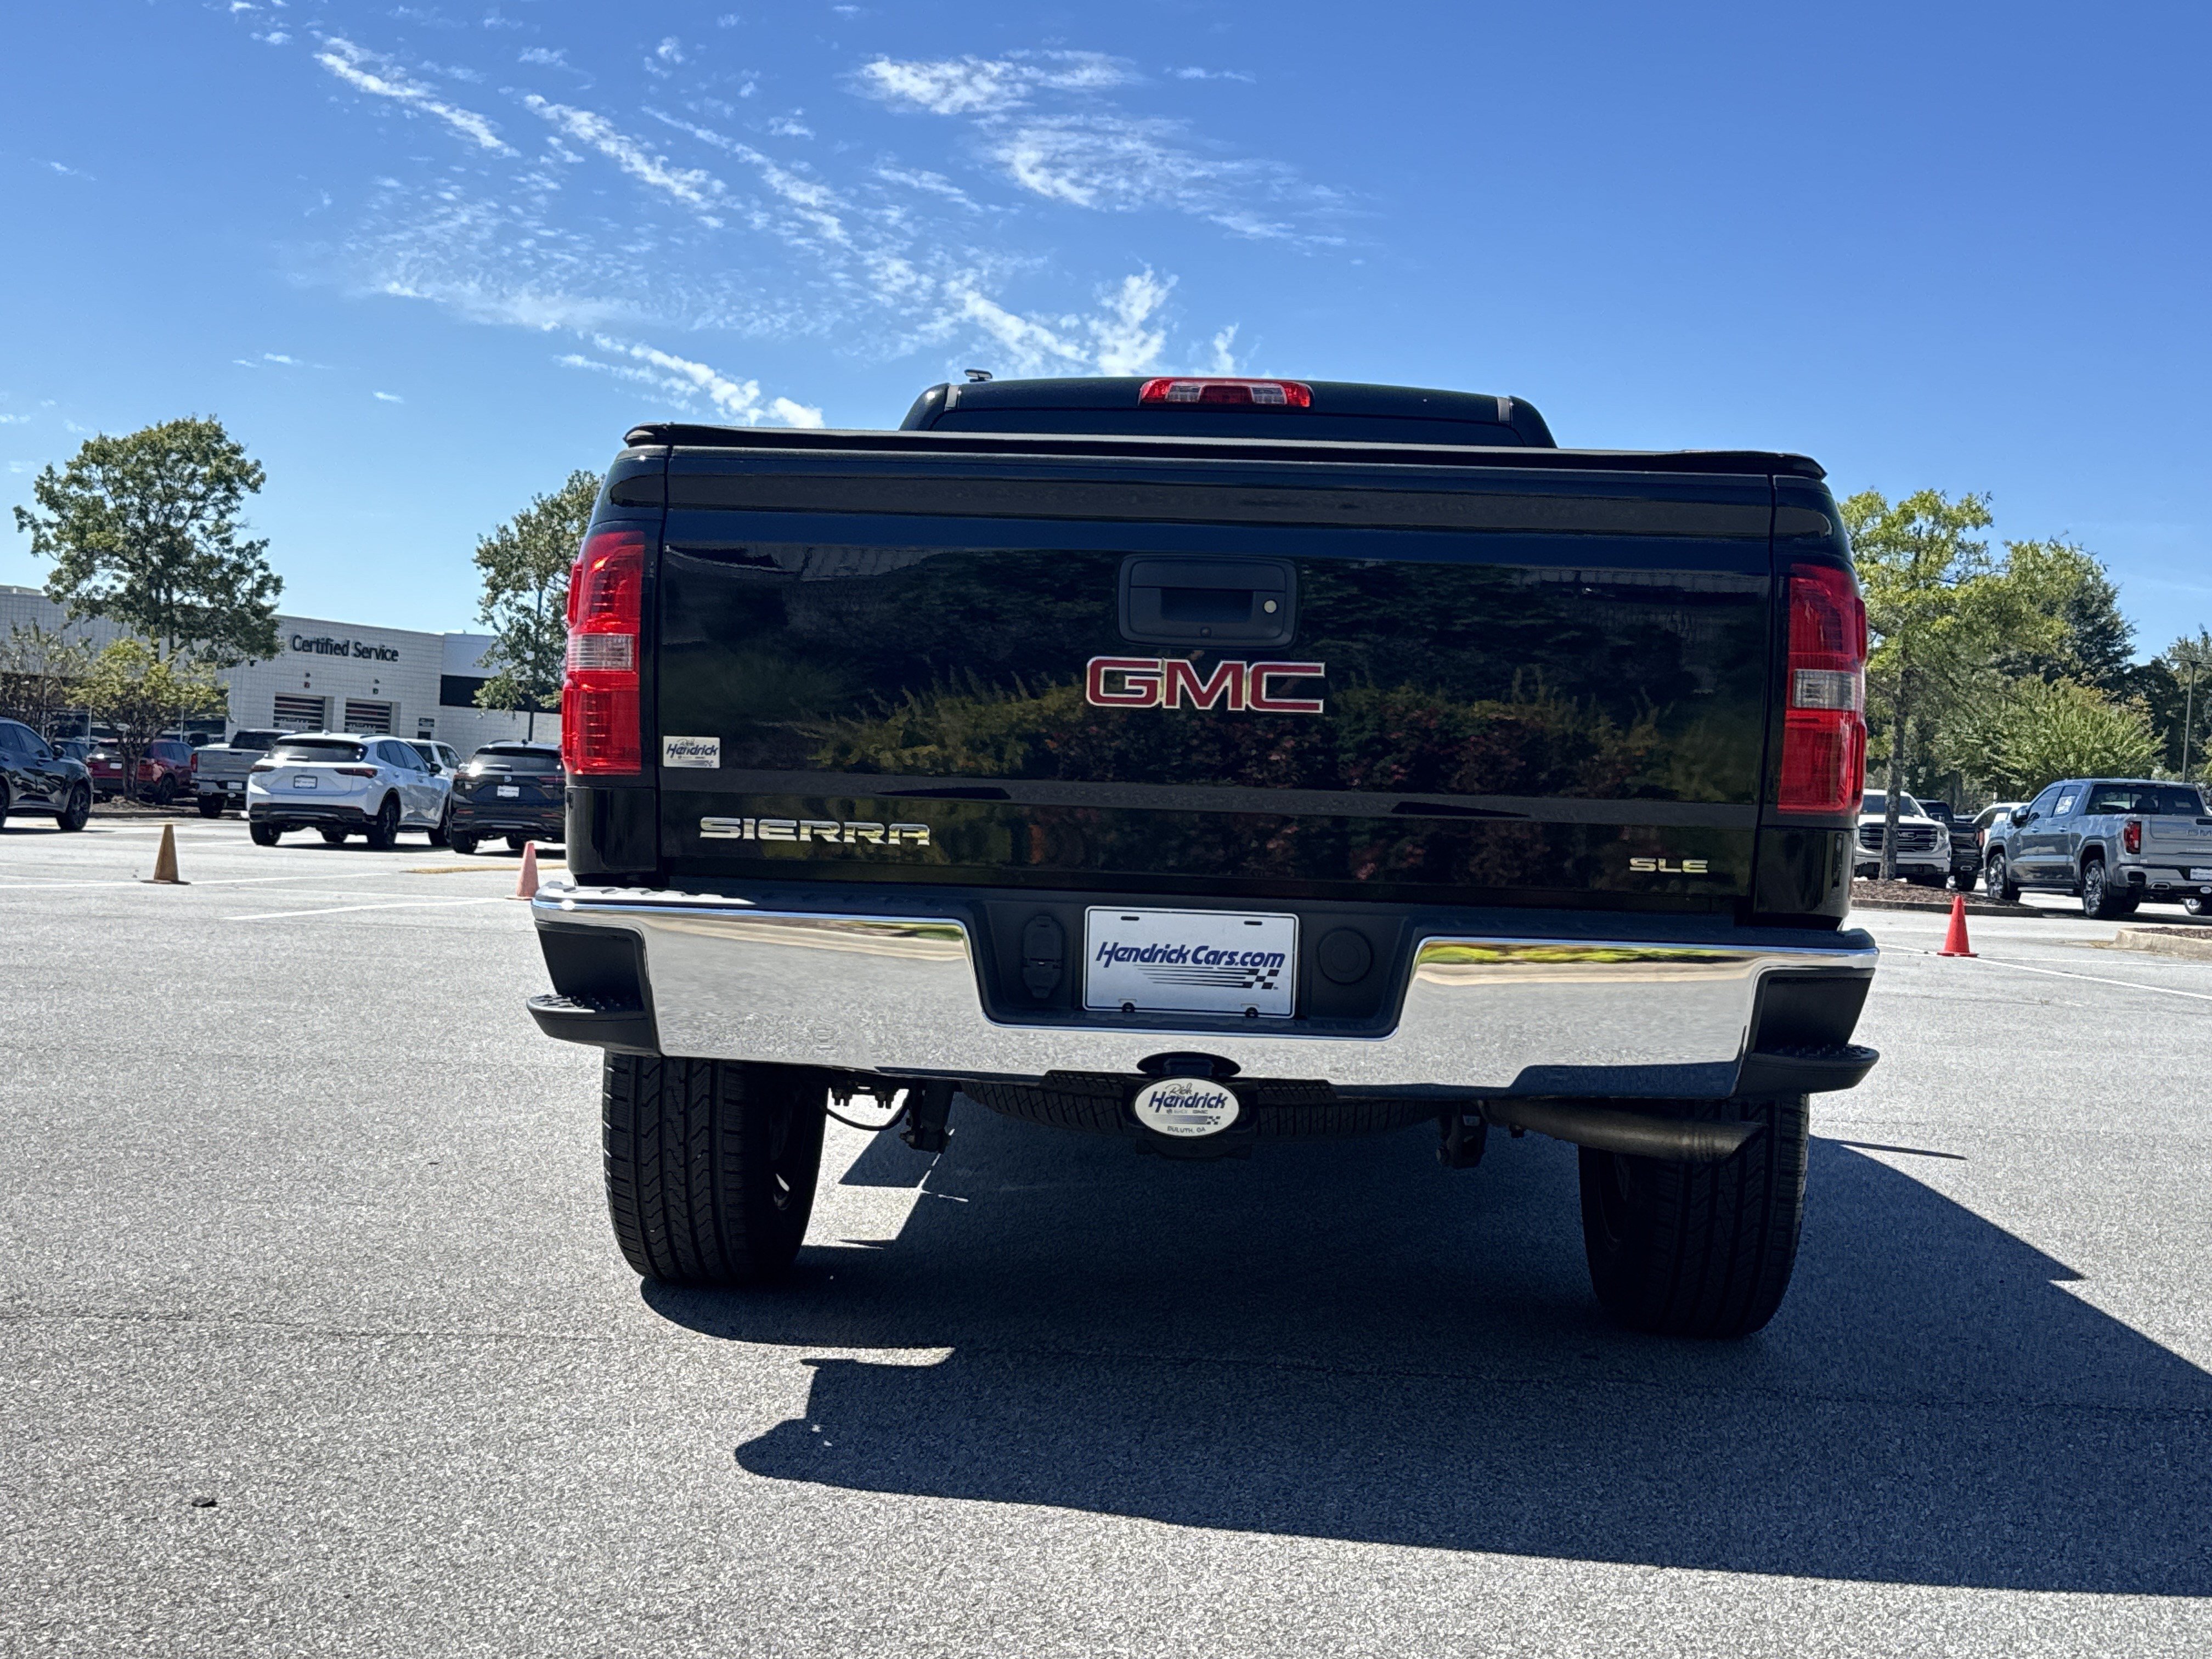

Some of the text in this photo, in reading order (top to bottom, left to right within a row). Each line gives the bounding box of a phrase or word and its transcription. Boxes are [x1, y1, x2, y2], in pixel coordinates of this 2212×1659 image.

[292, 634, 399, 662] Certified Service
[1086, 657, 1325, 713] GMC
[666, 743, 719, 759] Hendrick
[699, 816, 930, 846] SIERRA
[1629, 857, 1708, 873] SLE
[1148, 1091, 1228, 1113] Hendrick
